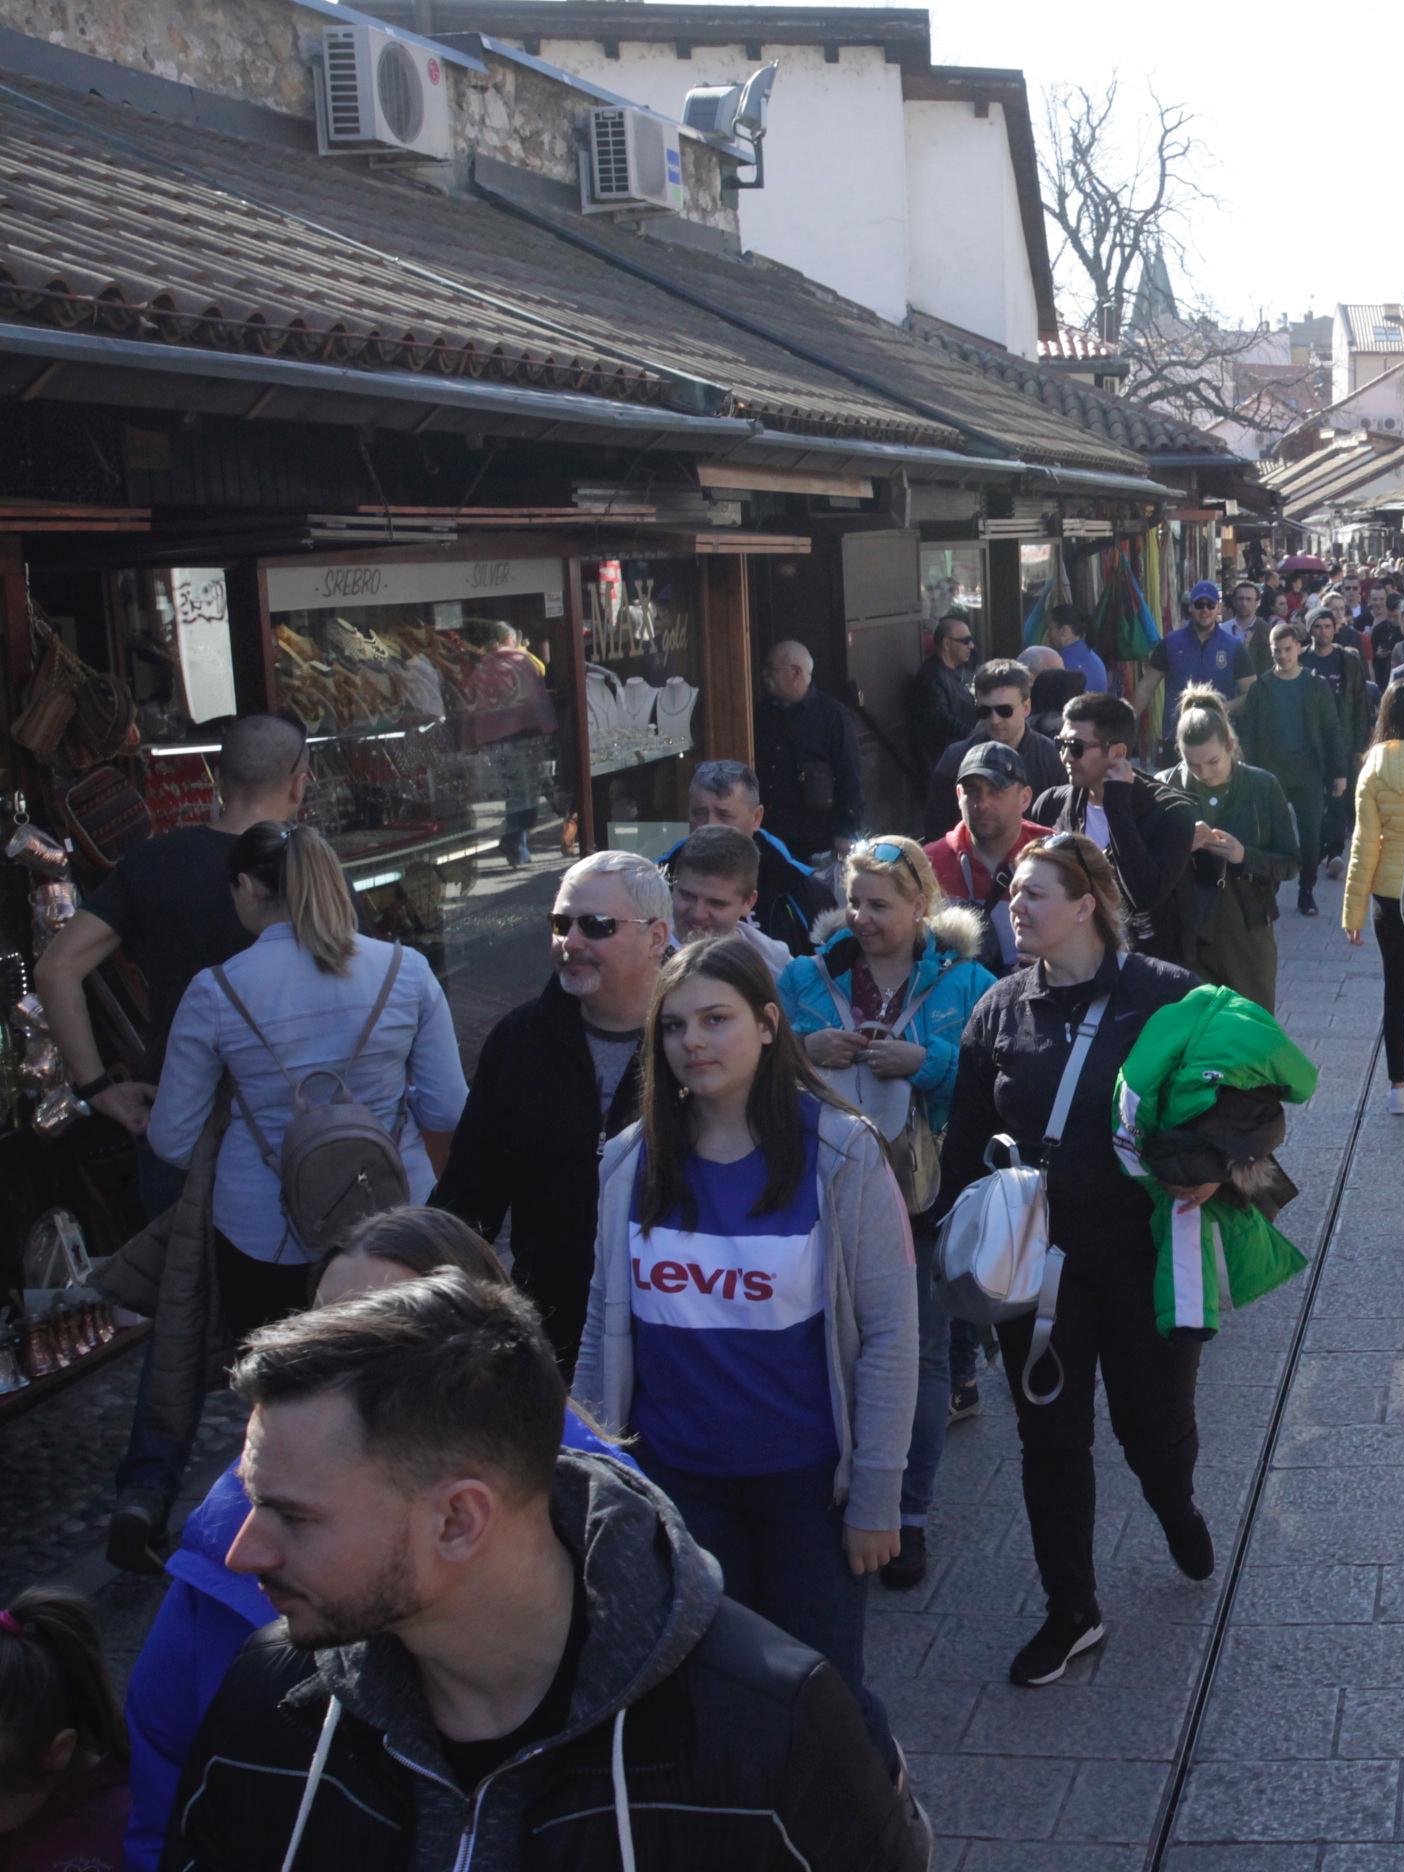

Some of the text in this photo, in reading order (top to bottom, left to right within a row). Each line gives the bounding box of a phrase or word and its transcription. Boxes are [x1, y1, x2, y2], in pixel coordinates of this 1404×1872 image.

[322, 568, 382, 598] SREBRO
[471, 562, 511, 589] SILVER
[587, 579, 658, 662] MAX
